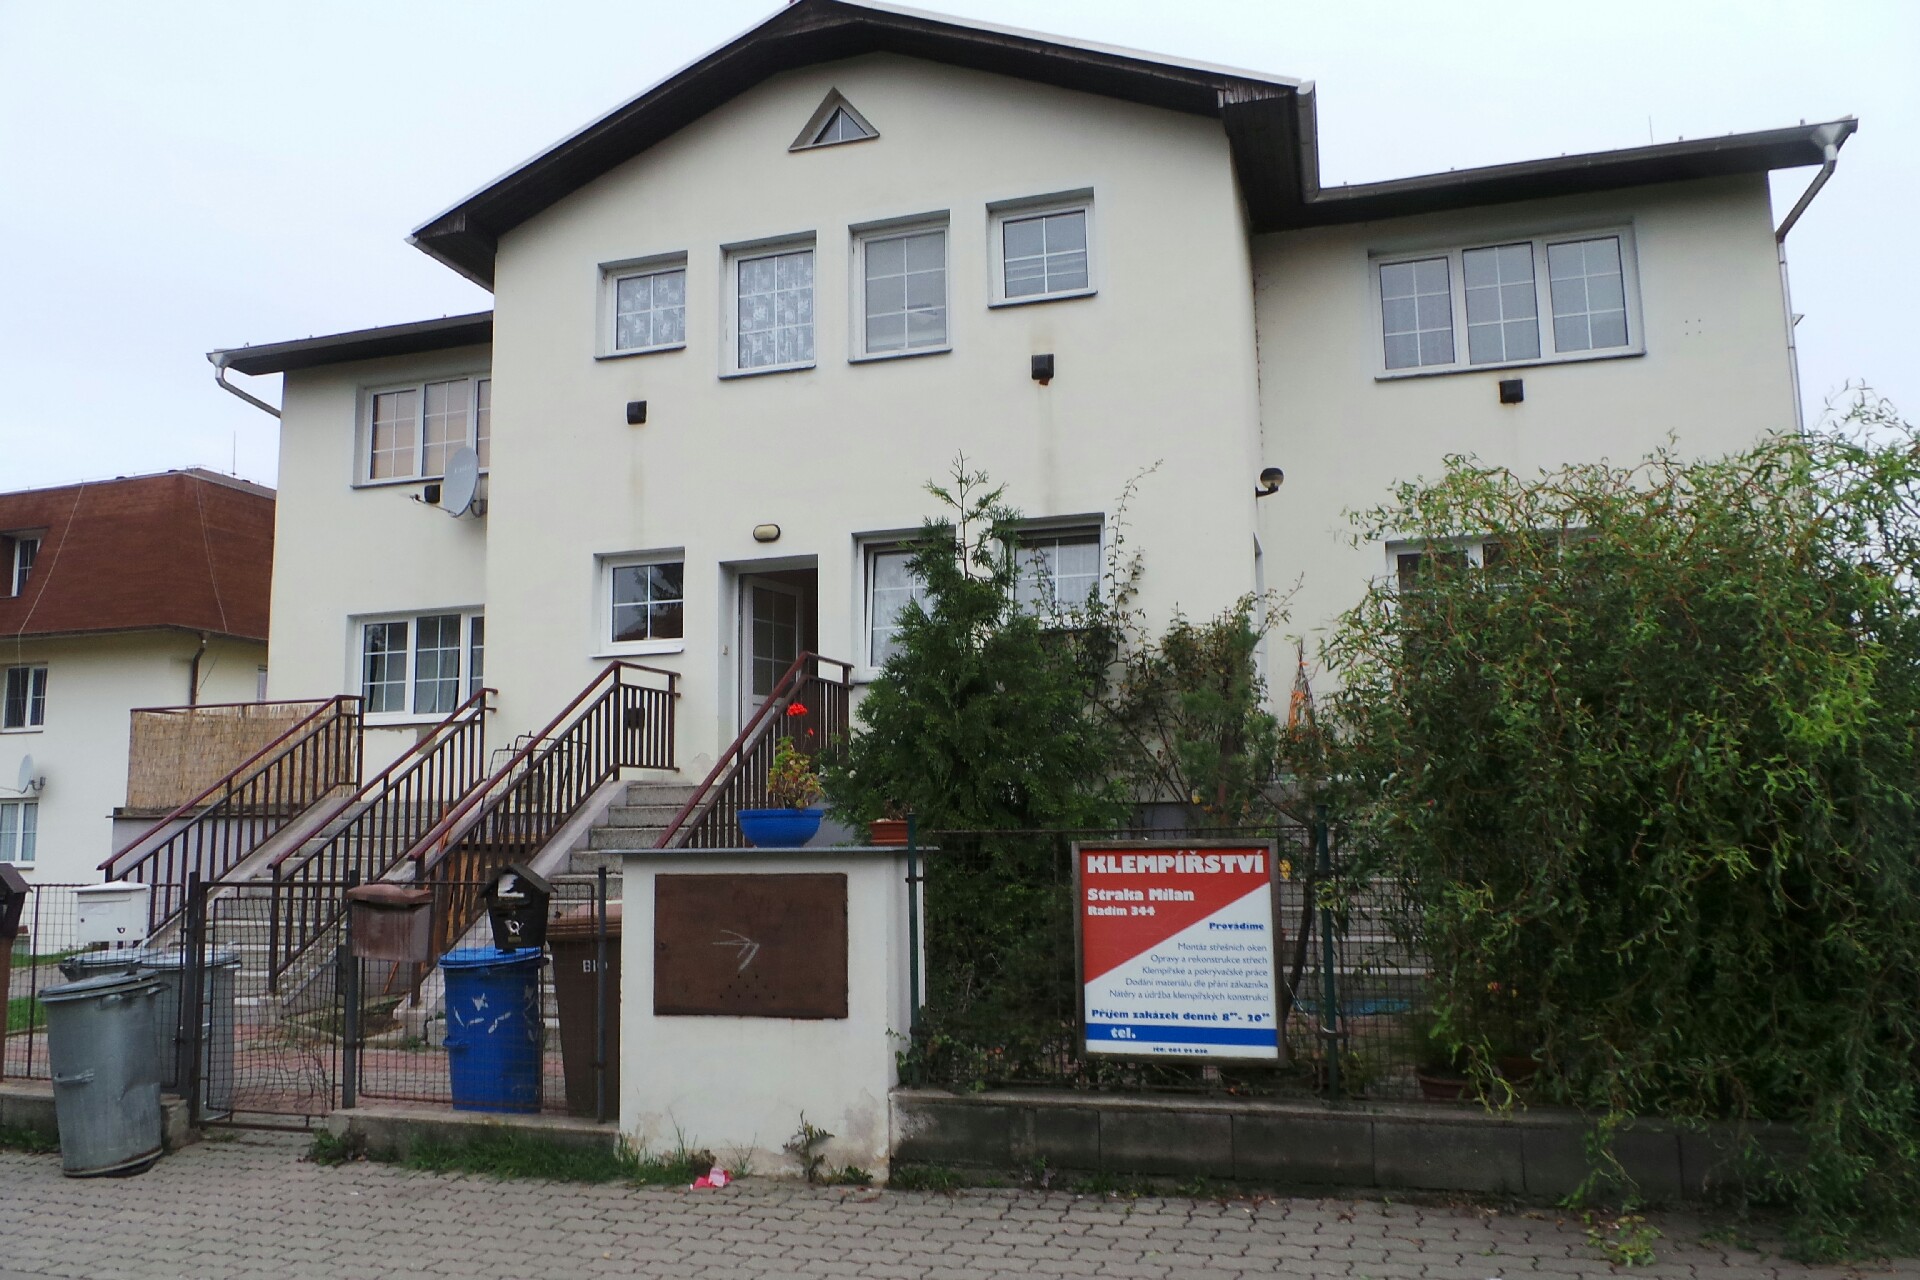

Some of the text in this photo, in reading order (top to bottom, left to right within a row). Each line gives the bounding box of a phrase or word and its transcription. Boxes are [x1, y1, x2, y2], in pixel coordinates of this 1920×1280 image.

[1087, 850, 1265, 874] KLEMPÍŘSTVÍ
[1087, 887, 1195, 902] Straka Milan
[1087, 905, 1156, 916] Radim 344
[1246, 943, 1268, 952] oken
[1150, 954, 1179, 964] Opravy
[1188, 955, 1241, 964] rekonstrukce
[1242, 956, 1268, 965] střech
[1245, 968, 1268, 978] práce
[1194, 979, 1206, 988] dle
[1091, 1008, 1129, 1019] Příjem
[1110, 1026, 1137, 1039] tel.
